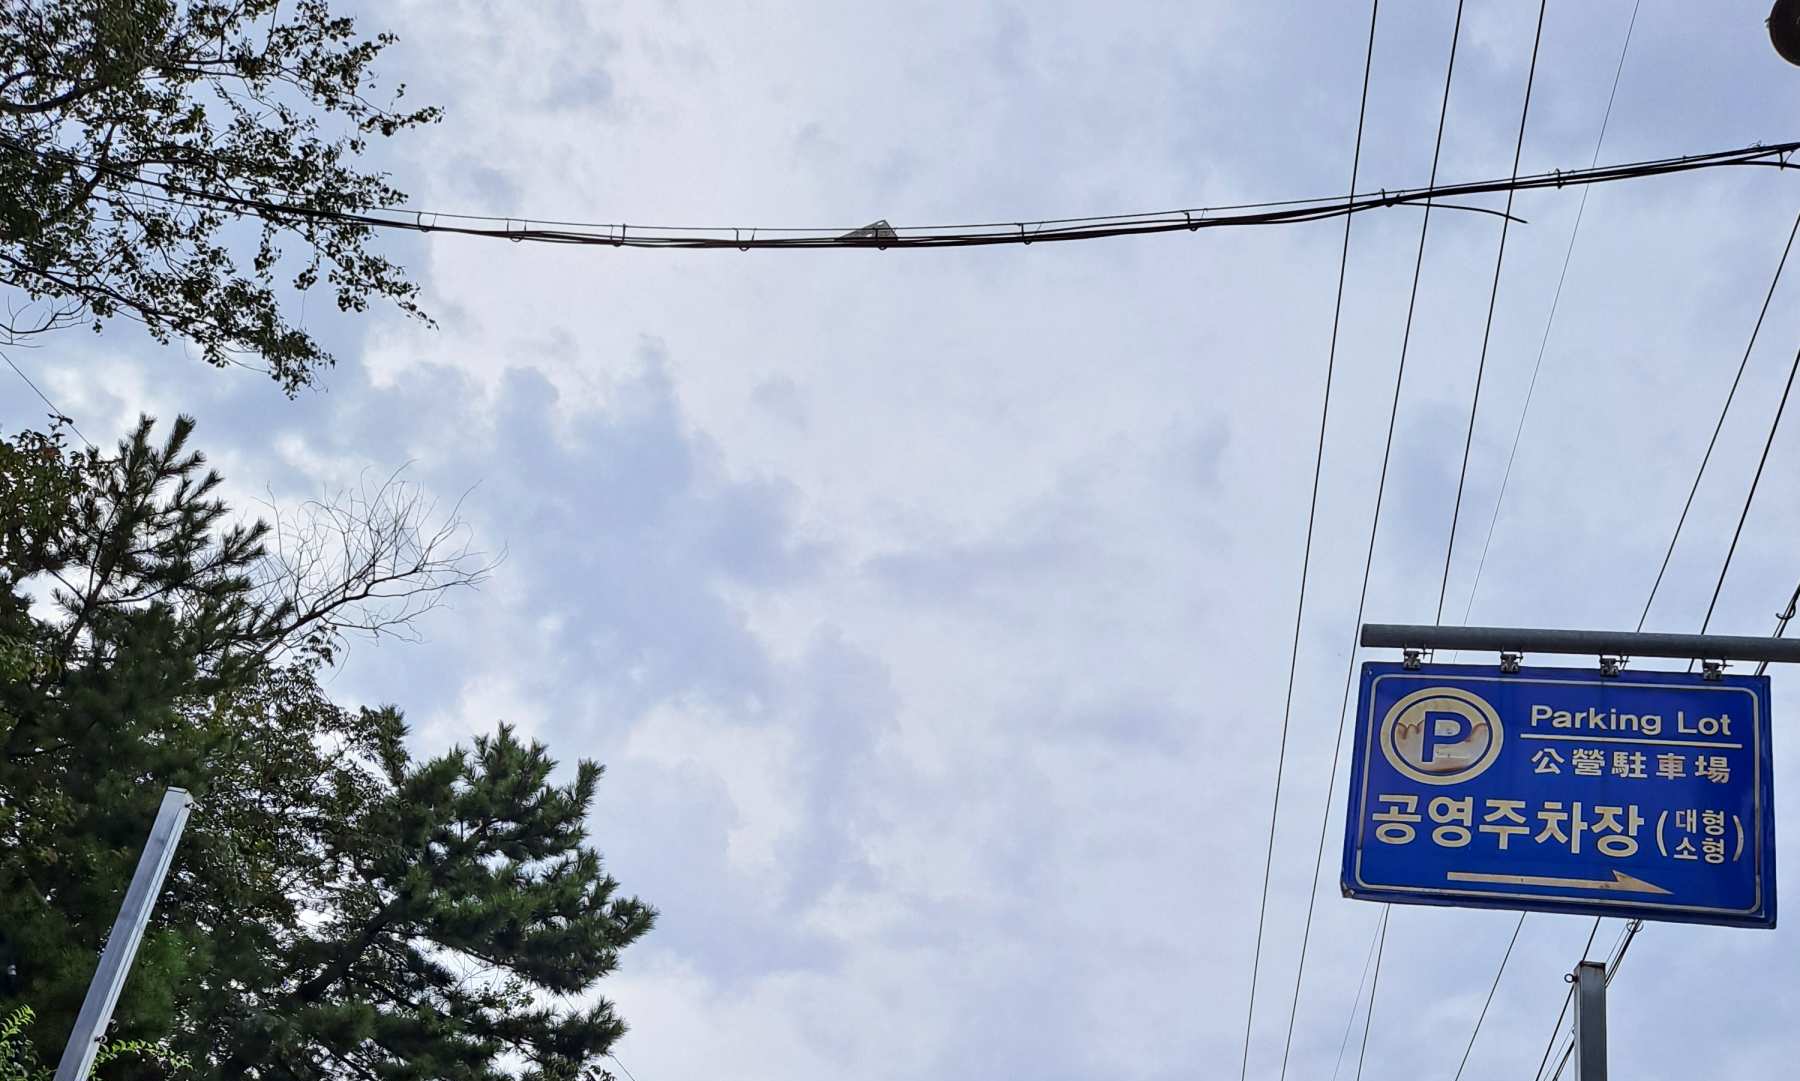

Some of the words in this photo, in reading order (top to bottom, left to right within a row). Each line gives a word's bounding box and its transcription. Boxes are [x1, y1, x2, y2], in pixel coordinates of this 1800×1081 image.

[1421, 709, 1473, 764] P
[1530, 704, 1662, 736] Parking
[1677, 711, 1732, 736] Lot
[1531, 747, 1731, 784] 公營駐車場
[1372, 793, 1645, 858] 공영주차장
